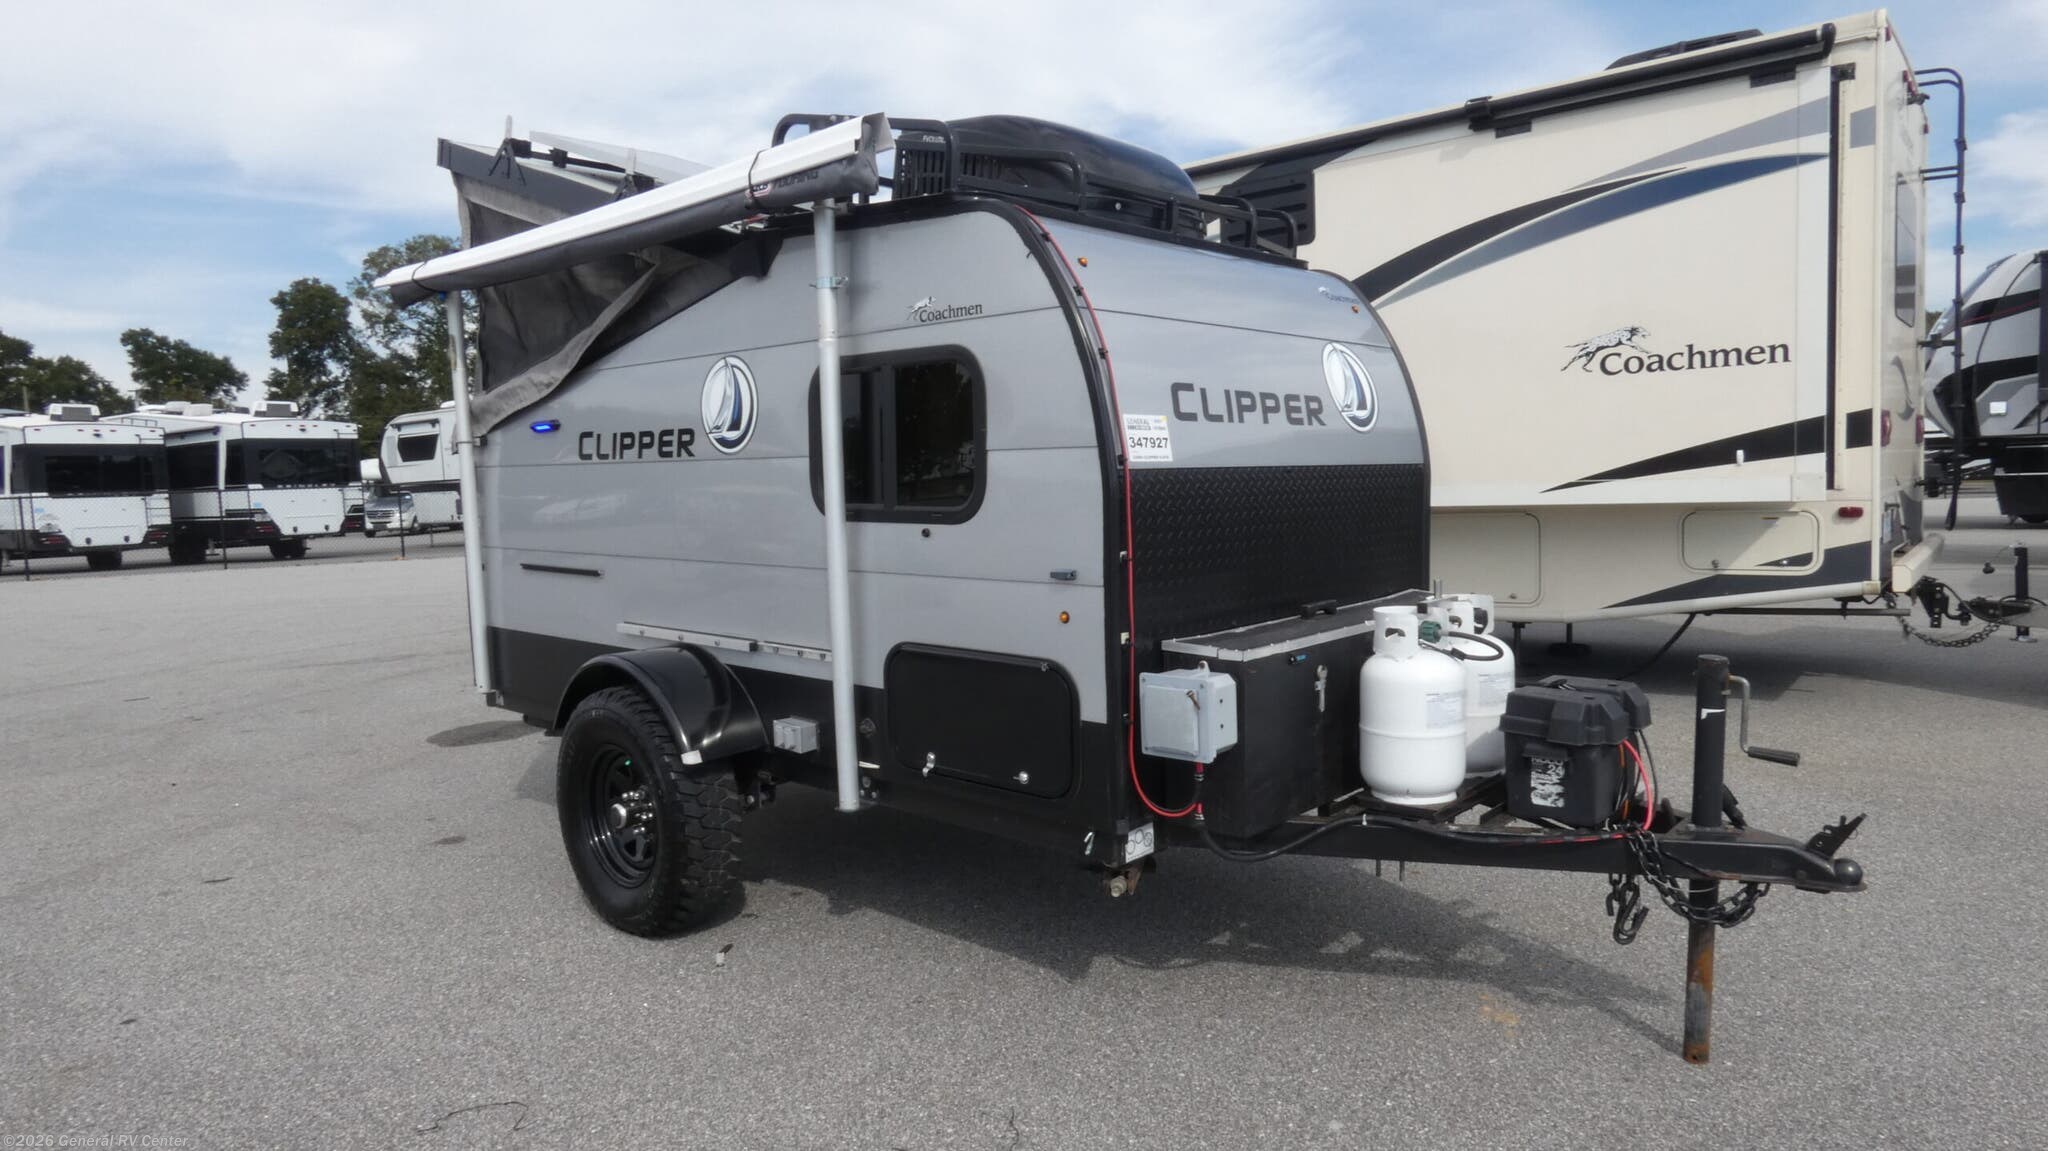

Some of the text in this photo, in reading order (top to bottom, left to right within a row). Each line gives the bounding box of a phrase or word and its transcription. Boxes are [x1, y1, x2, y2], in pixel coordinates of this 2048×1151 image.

[919, 304, 983, 323] Coachmen
[1599, 342, 1791, 377] Coachmen
[1170, 382, 1327, 427] CLIPPER
[578, 428, 695, 461] CLIPPER
[1129, 437, 1168, 449] 347927
